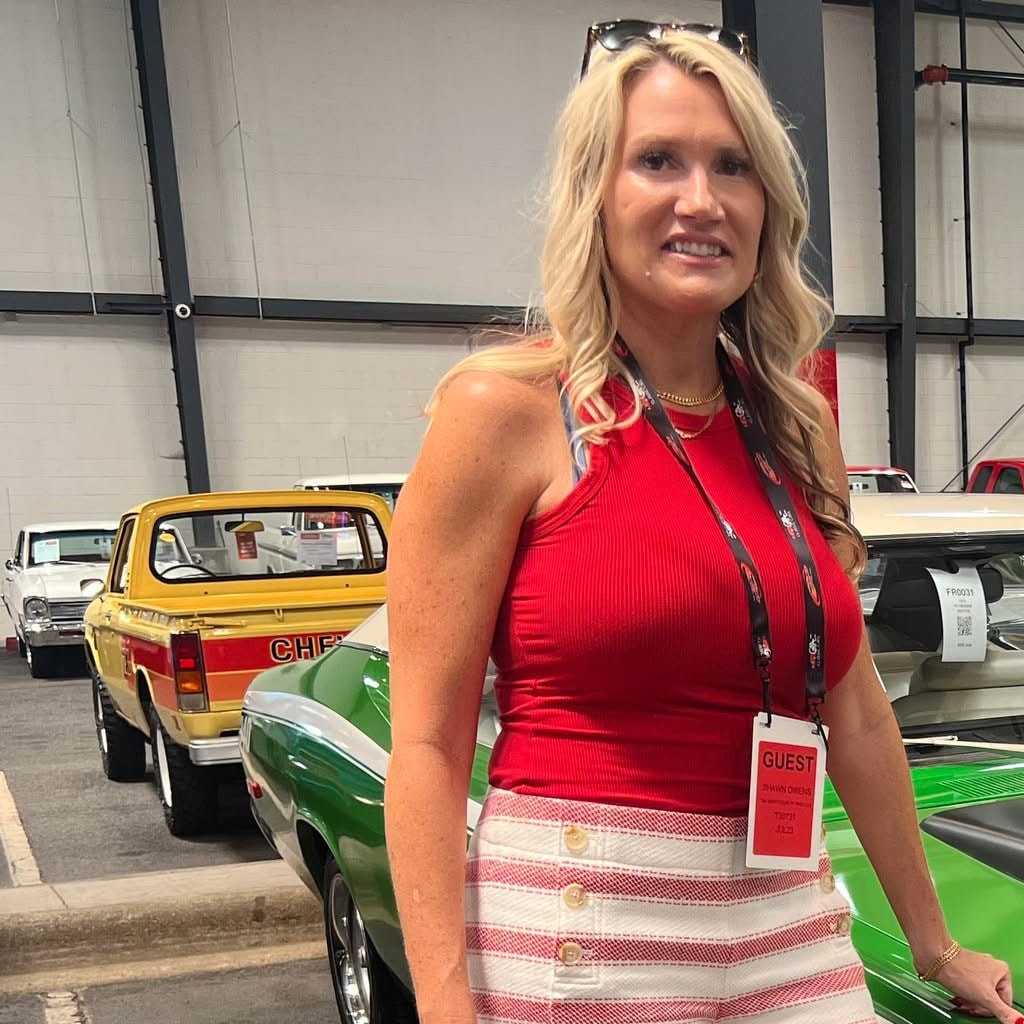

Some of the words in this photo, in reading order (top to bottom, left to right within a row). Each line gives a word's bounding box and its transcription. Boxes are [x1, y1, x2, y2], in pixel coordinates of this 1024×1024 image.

[946, 588, 974, 597] FR0031
[269, 634, 344, 664] CHE
[763, 751, 815, 773] GUEST
